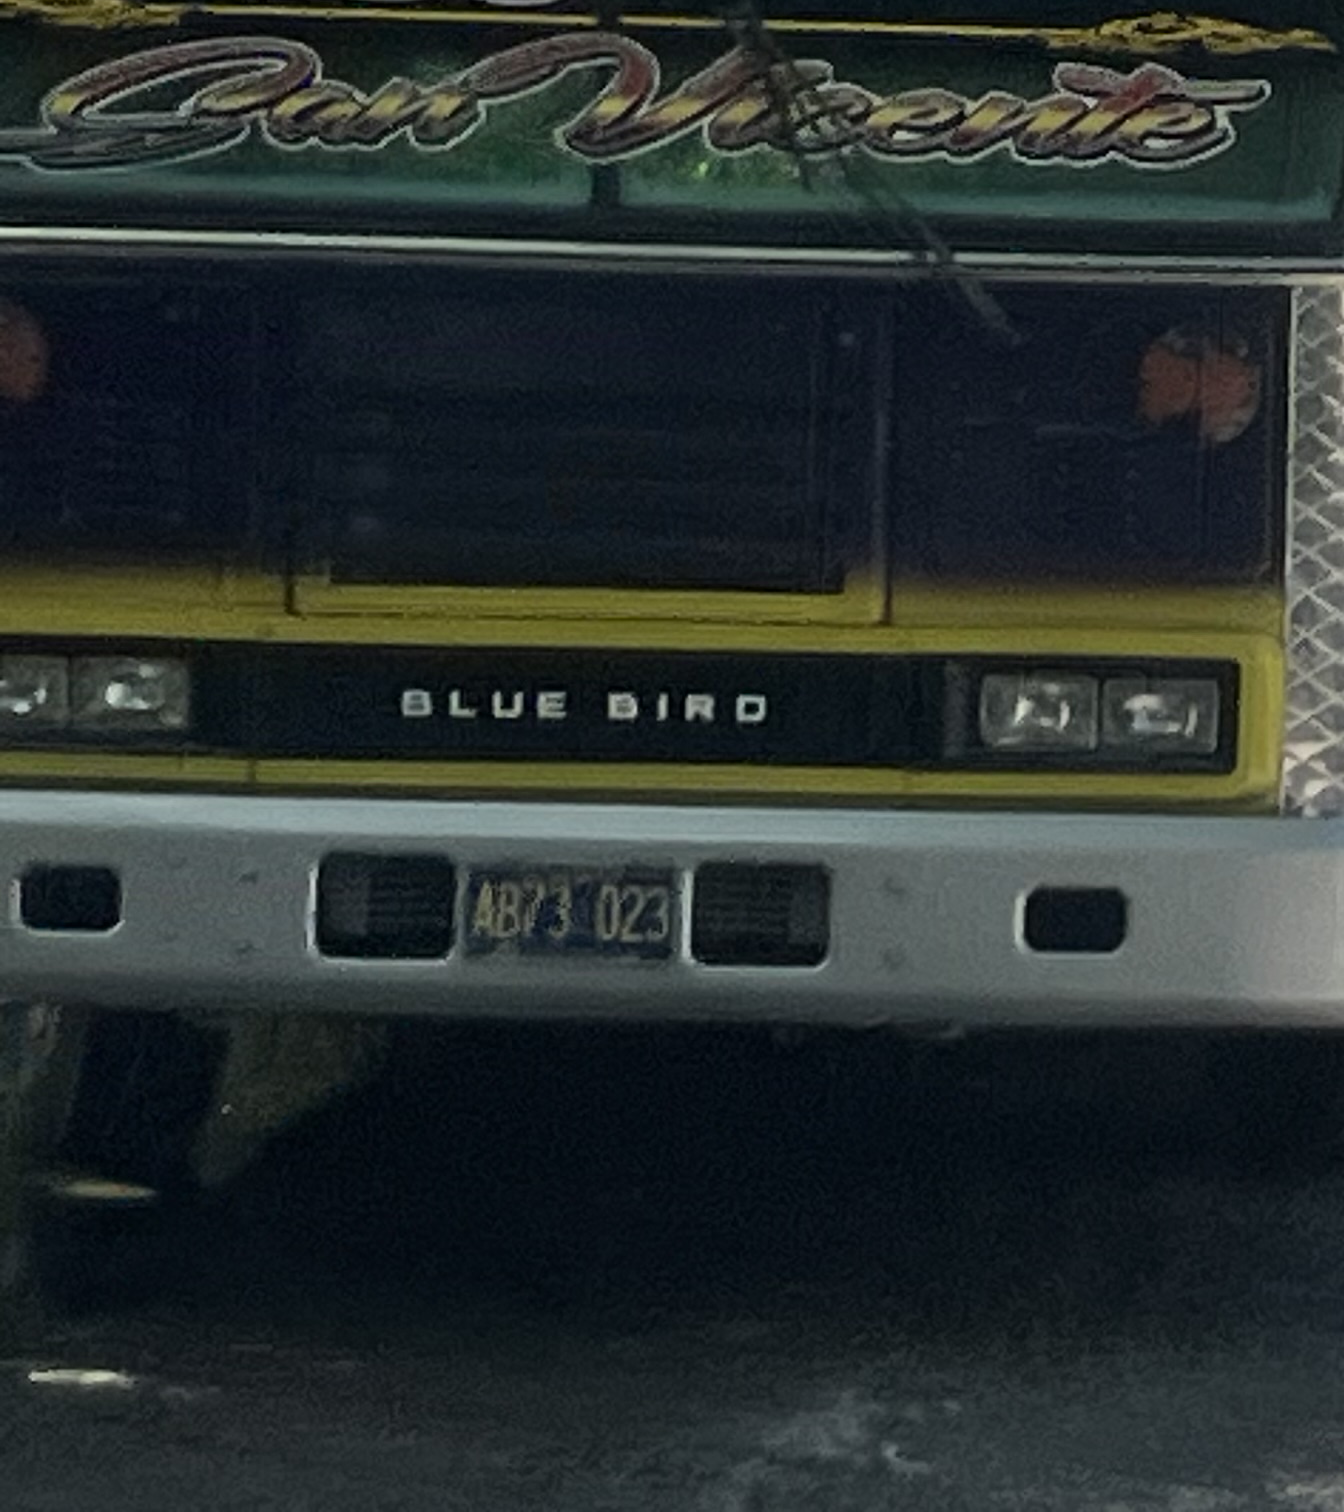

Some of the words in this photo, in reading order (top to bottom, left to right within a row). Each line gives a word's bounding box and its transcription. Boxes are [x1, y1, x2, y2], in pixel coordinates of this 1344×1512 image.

[0, 36, 485, 174] San
[400, 689, 568, 720] BLUE
[607, 691, 768, 723] BIRD
